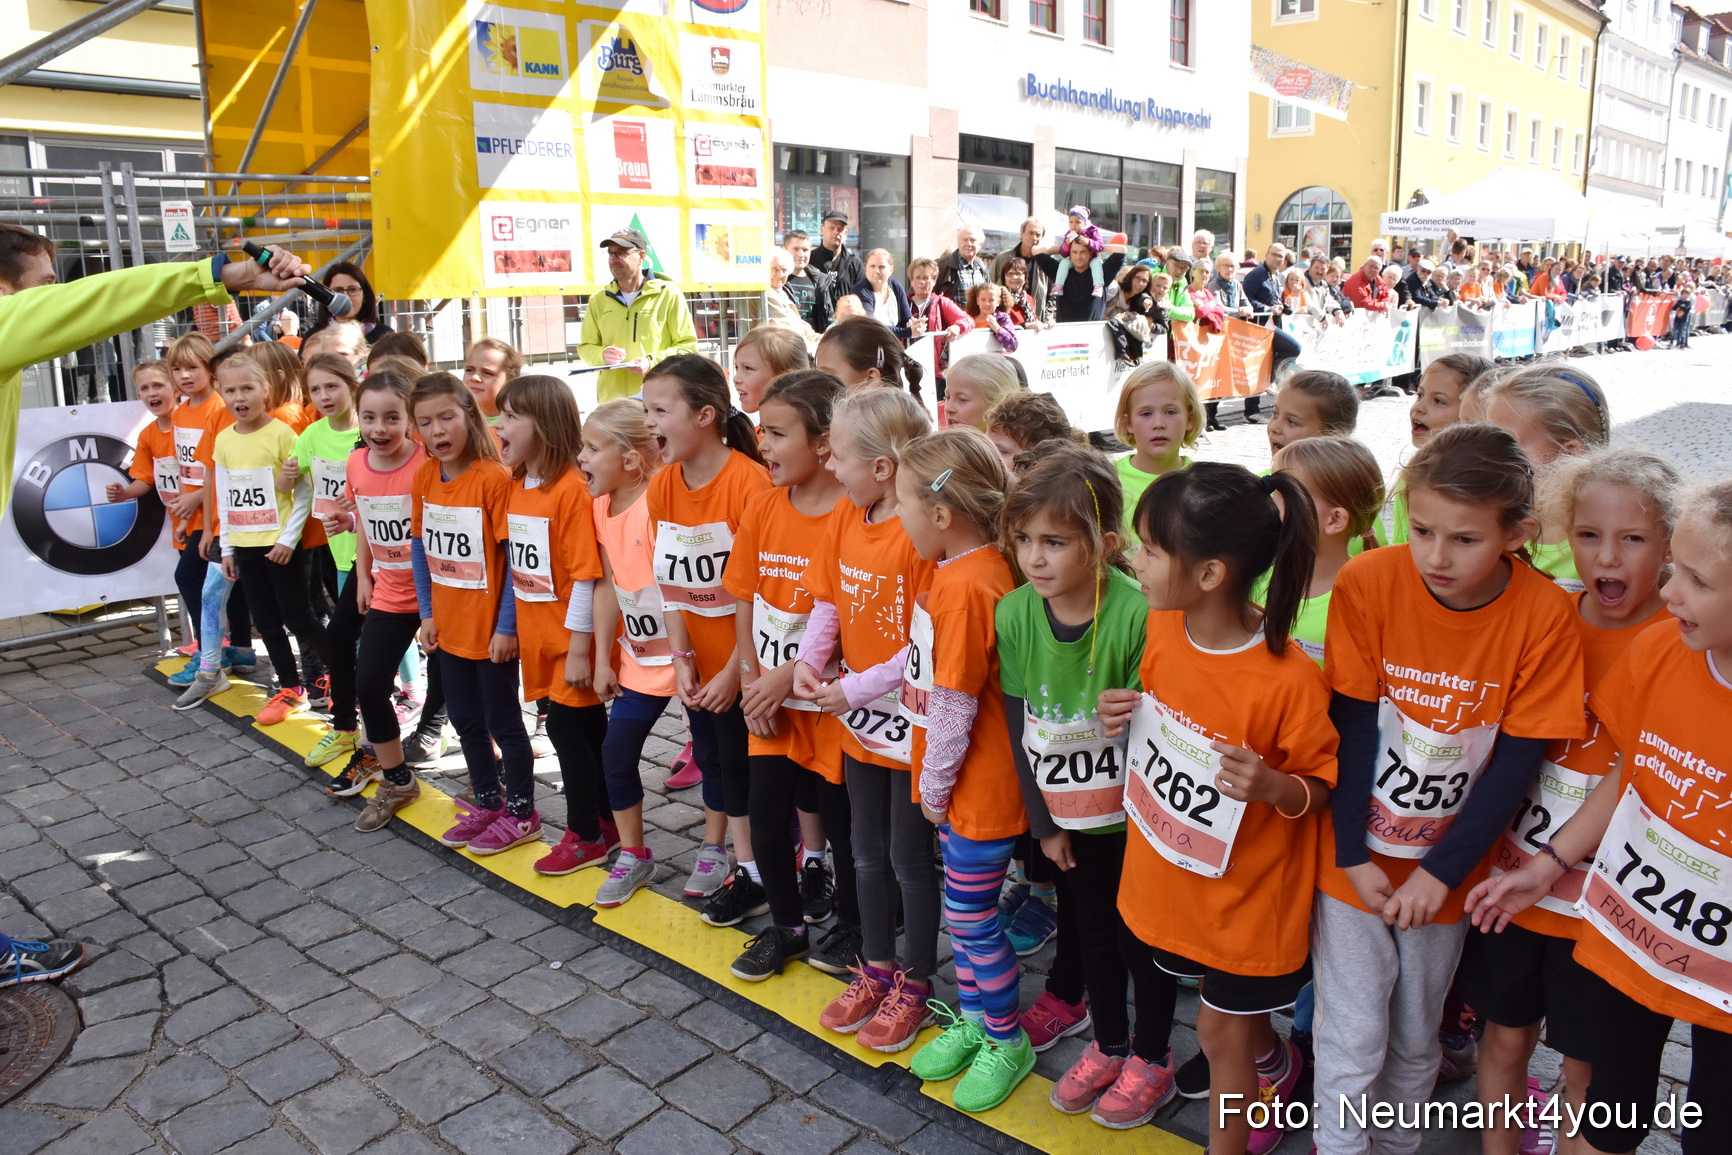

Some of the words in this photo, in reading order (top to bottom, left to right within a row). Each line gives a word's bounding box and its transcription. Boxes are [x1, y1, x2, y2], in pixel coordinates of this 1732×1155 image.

[525, 62, 559, 75] KANN
[597, 46, 643, 76] Burg
[691, 89, 755, 108] Lammsbräu
[1027, 72, 1141, 121] Buchhandlung
[1148, 97, 1212, 129] Rupprecht
[492, 137, 573, 158] PFLEIDERER
[616, 158, 649, 177] Braun
[515, 217, 570, 233] Egner
[1388, 216, 1410, 224] BMW
[1412, 217, 1476, 226] ConnectedDrive
[736, 255, 762, 264] KANN
[433, 511, 457, 521] BOCK
[368, 518, 412, 542] 7002
[425, 528, 471, 557] 7178
[388, 549, 401, 559] Eva
[665, 550, 731, 583] 7107
[440, 562, 456, 573] Julia
[688, 591, 716, 602] Tessa
[895, 574, 905, 642] BAMBINI
[847, 706, 910, 743] 073
[1049, 728, 1098, 743] BOCK
[1168, 731, 1212, 766] BOCK
[1411, 737, 1463, 757] BOCK
[1028, 745, 1119, 785] 7204
[1144, 738, 1220, 827] 7262
[1376, 747, 1469, 810] 7253
[1139, 787, 1193, 850] Fiona
[1658, 837, 1721, 881] BOCK
[1615, 841, 1732, 946] 7248
[1600, 894, 1692, 973] FRANCA
